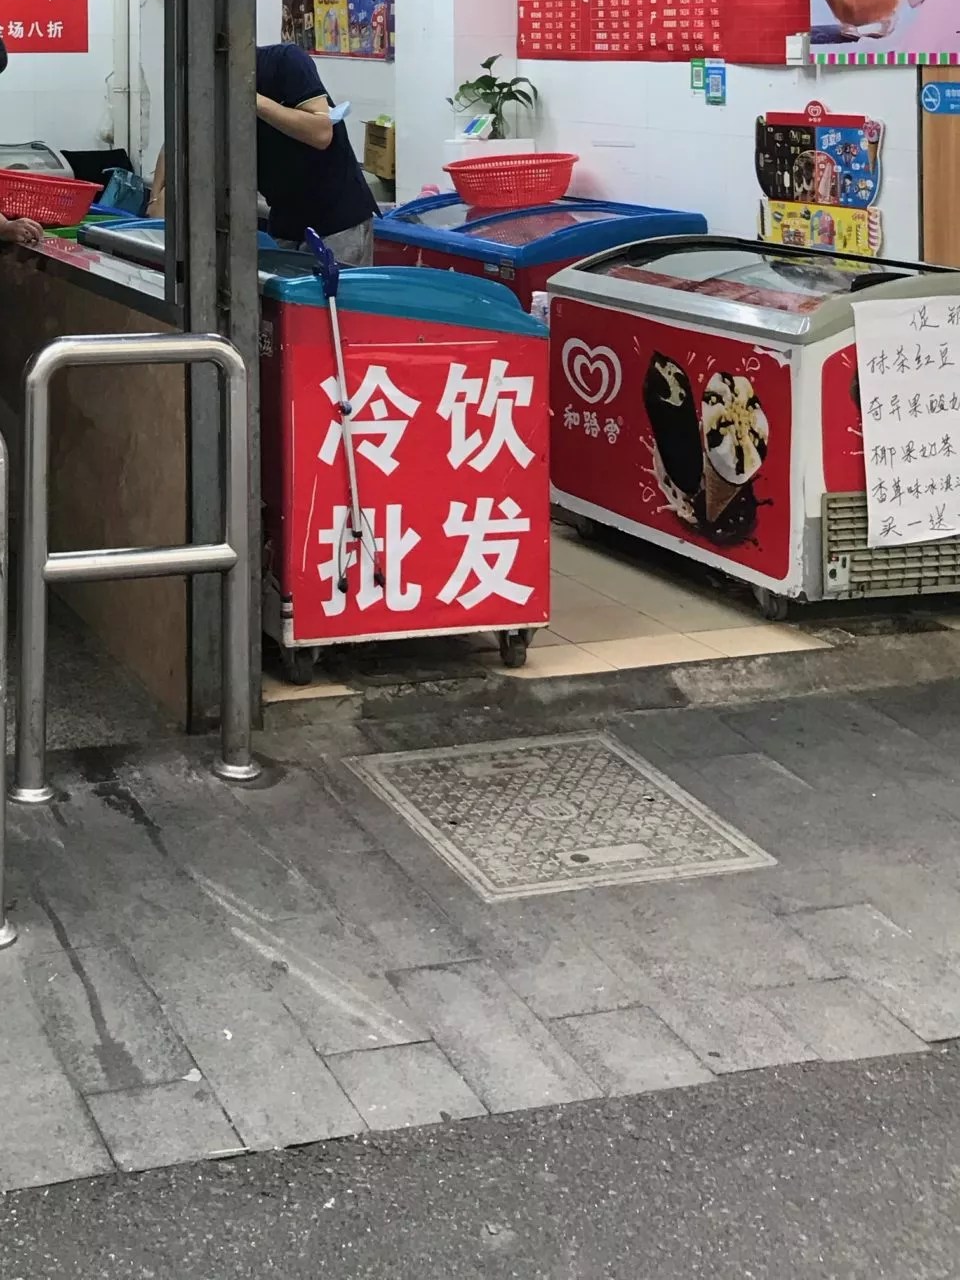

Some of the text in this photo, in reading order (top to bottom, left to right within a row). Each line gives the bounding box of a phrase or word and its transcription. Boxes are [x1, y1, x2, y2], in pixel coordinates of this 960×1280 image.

[866, 343, 955, 375] 抹茶红豆
[317, 359, 535, 476] 冷饮
[317, 497, 535, 617] 批发
[879, 503, 960, 537] 买一送
